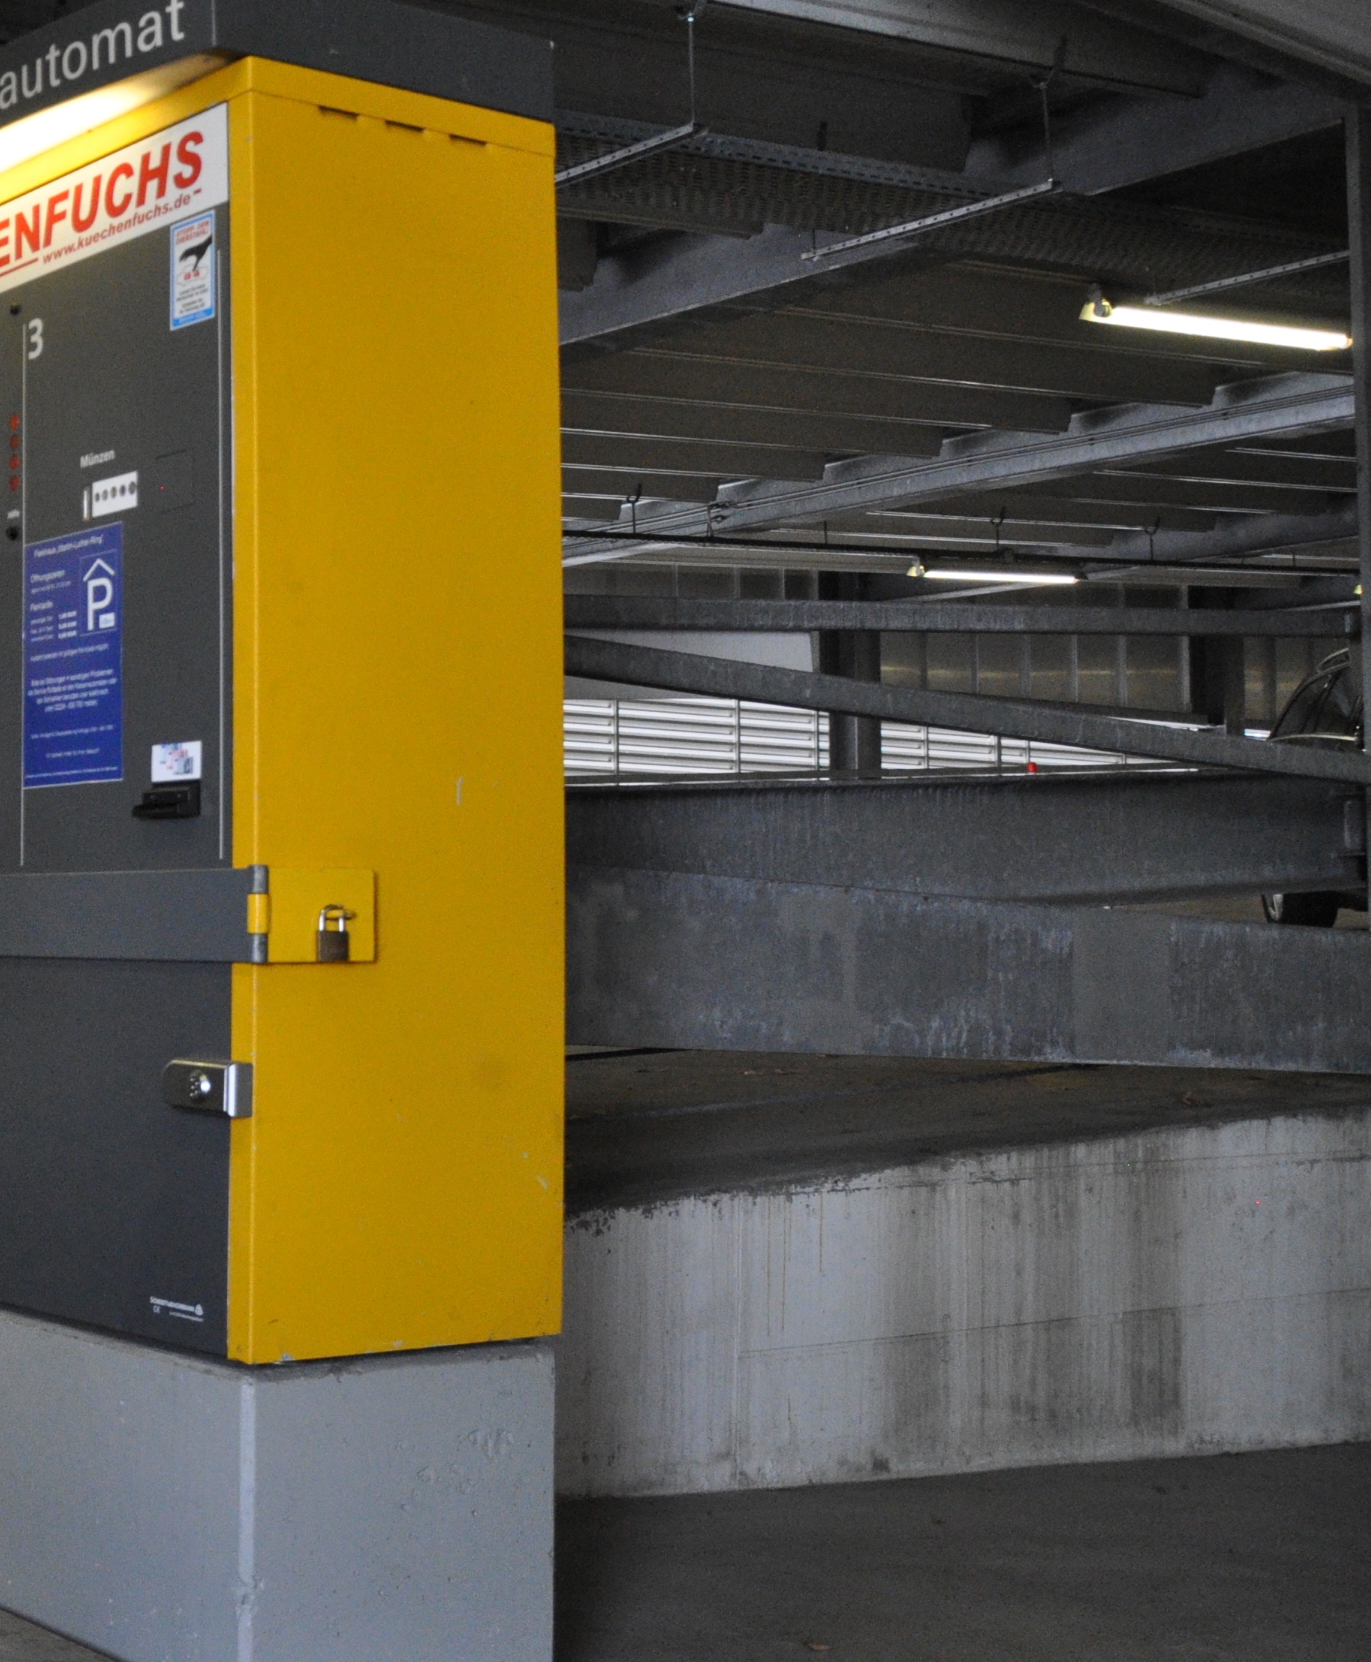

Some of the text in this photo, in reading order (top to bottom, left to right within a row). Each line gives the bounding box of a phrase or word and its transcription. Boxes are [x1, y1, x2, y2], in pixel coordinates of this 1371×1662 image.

[42, 193, 190, 264] www.kuechenfuchs.de
[28, 317, 44, 360] 3
[80, 449, 115, 468] Münzen
[87, 577, 113, 631] P
